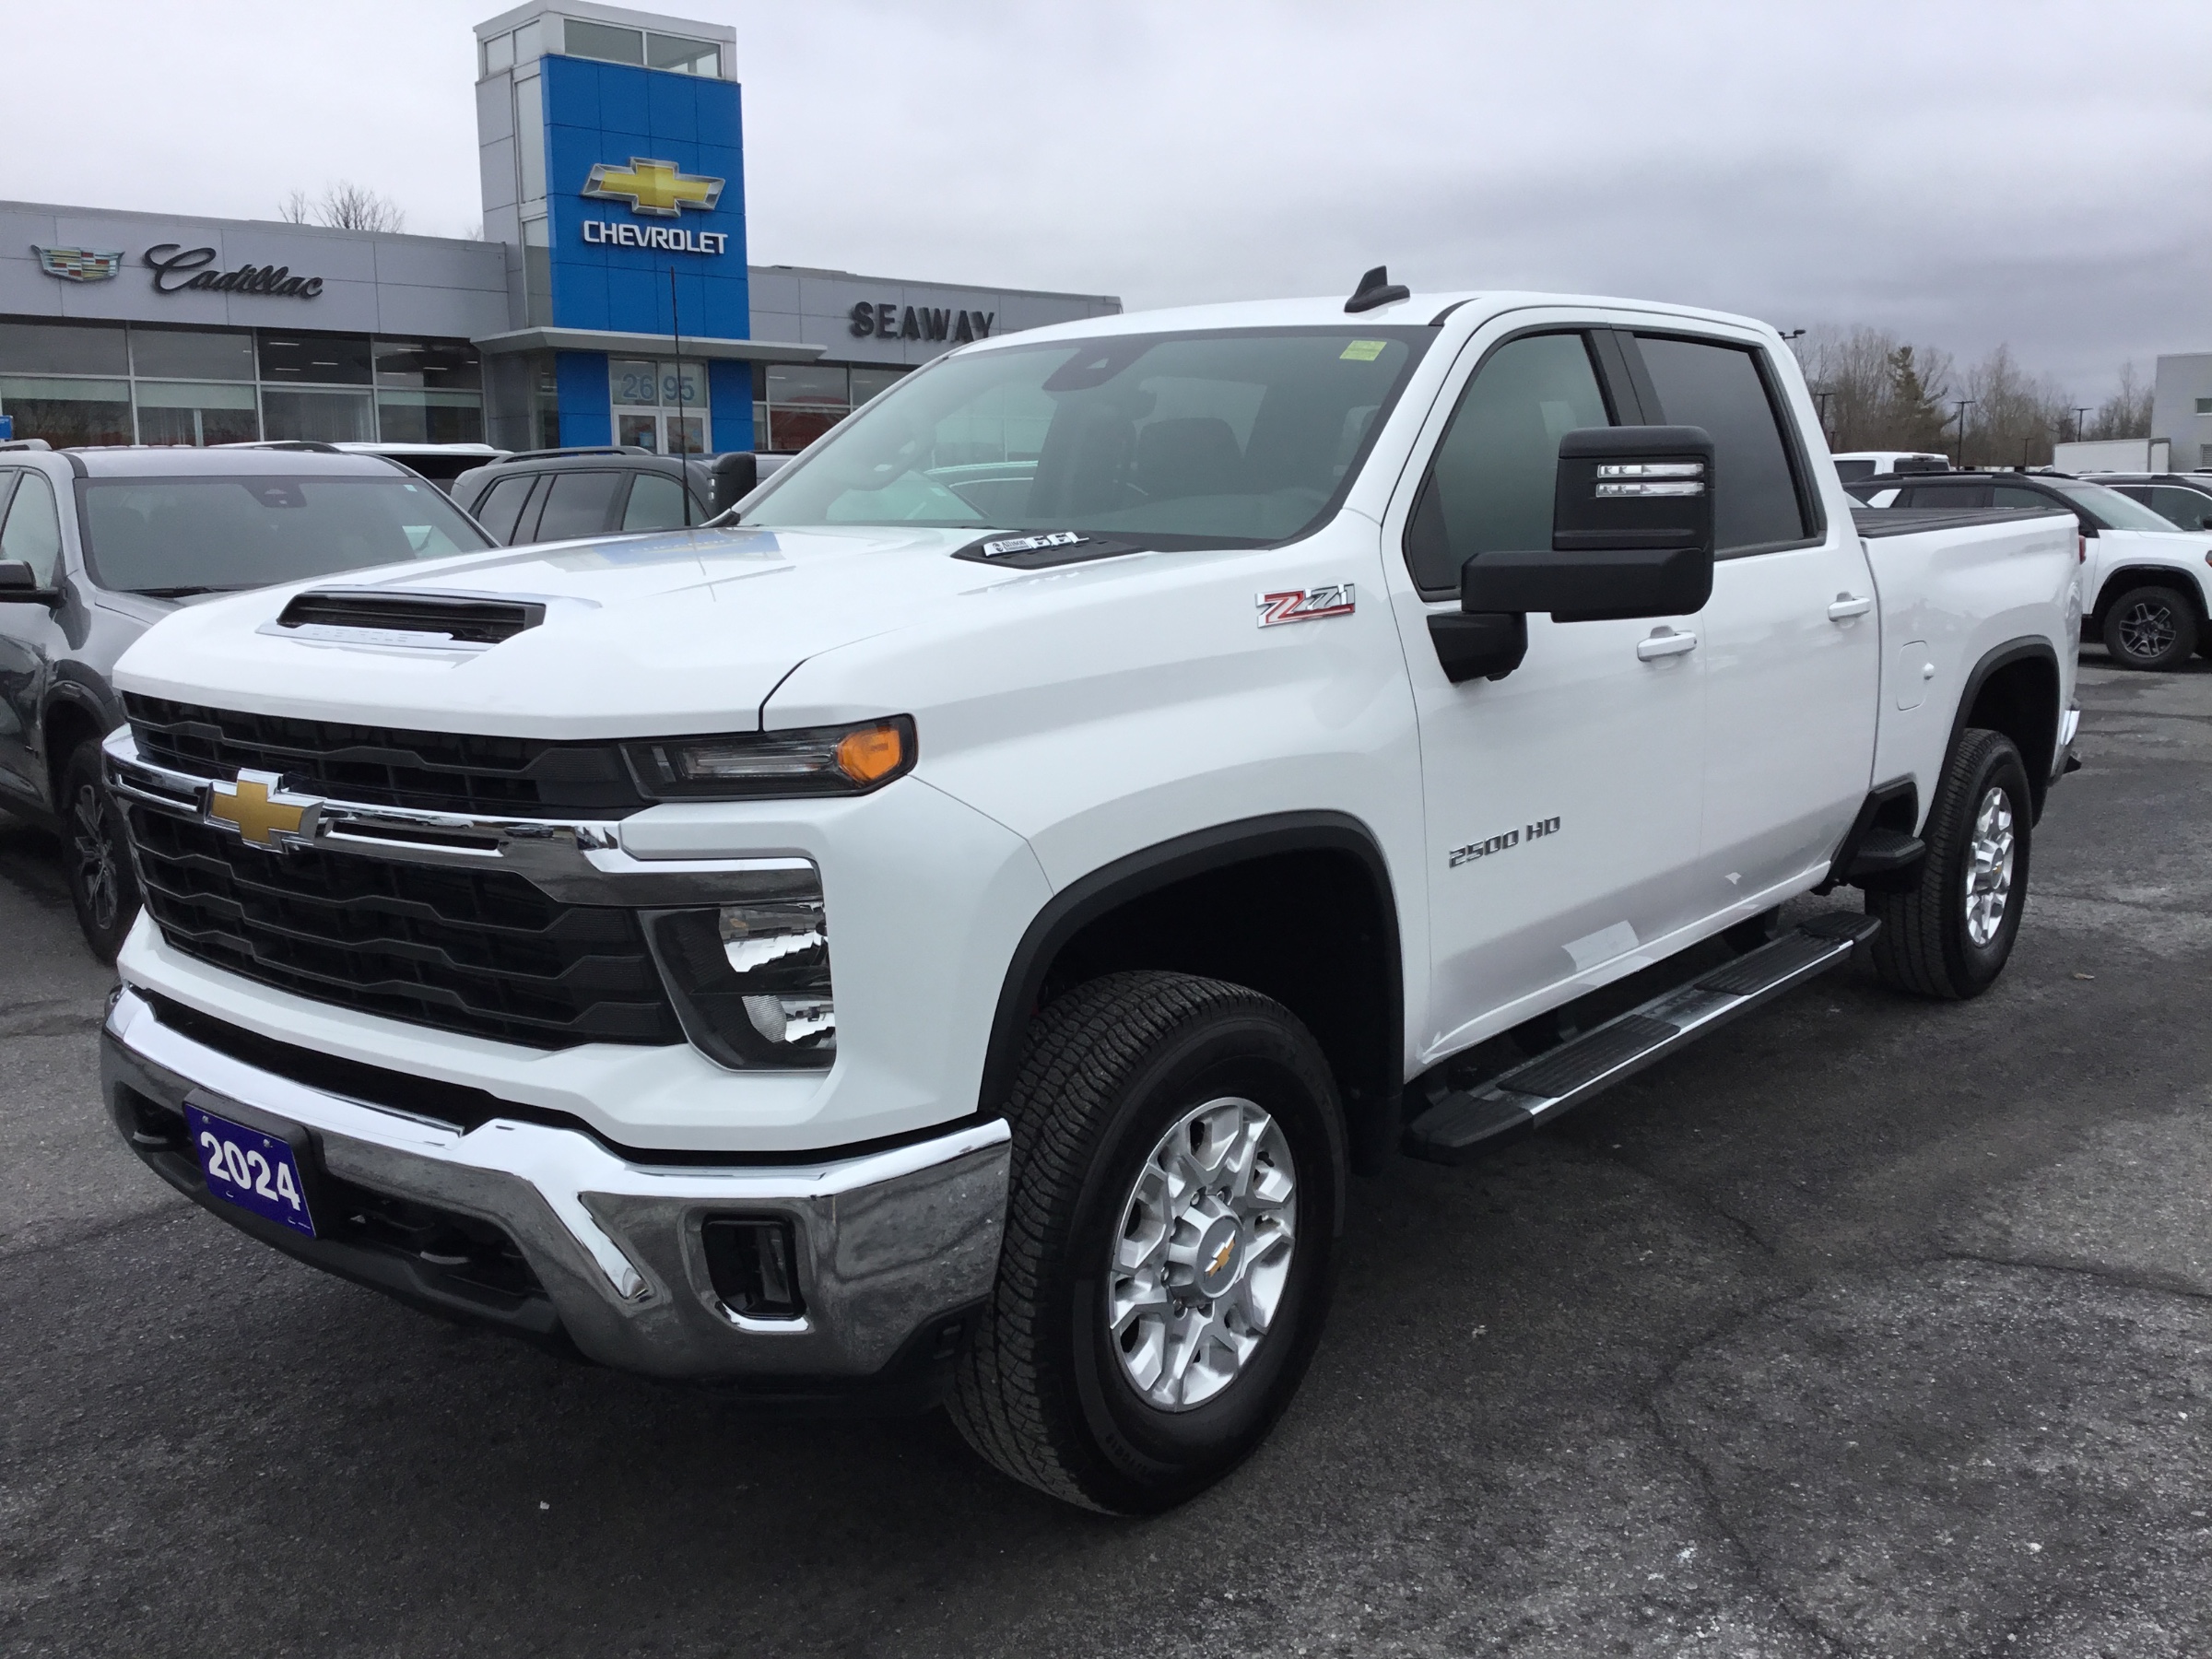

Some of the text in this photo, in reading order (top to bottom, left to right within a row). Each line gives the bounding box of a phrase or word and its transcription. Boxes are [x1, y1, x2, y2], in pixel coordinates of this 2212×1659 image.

[582, 219, 729, 254] CHEVROLET
[144, 243, 324, 299] Cadillac
[850, 300, 995, 342] SEAWAY
[1254, 582, 1356, 629] Z71
[1449, 816, 1561, 868] 2500 HD
[200, 1130, 301, 1212] 2024
